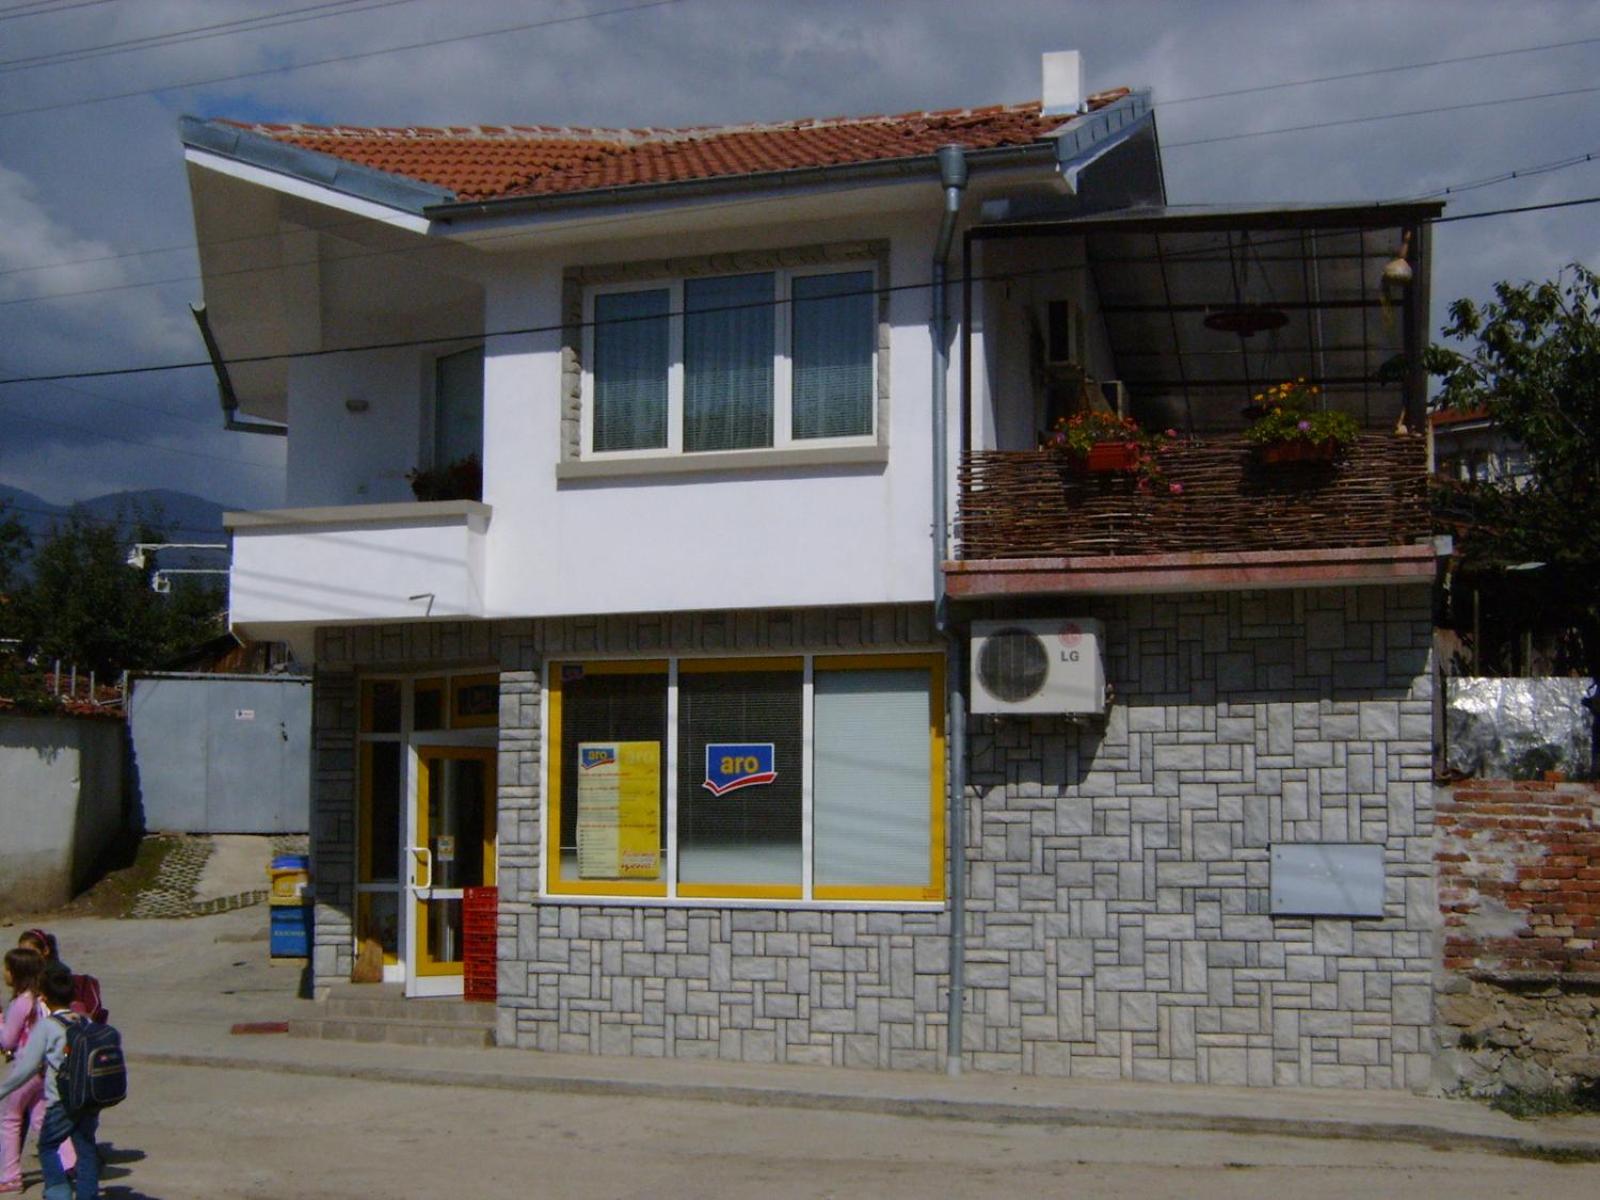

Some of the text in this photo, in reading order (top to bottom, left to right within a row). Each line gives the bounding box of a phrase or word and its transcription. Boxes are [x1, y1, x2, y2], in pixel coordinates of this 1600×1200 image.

[1061, 650, 1079, 662] LG
[588, 751, 607, 760] aro
[720, 756, 759, 774] aro
